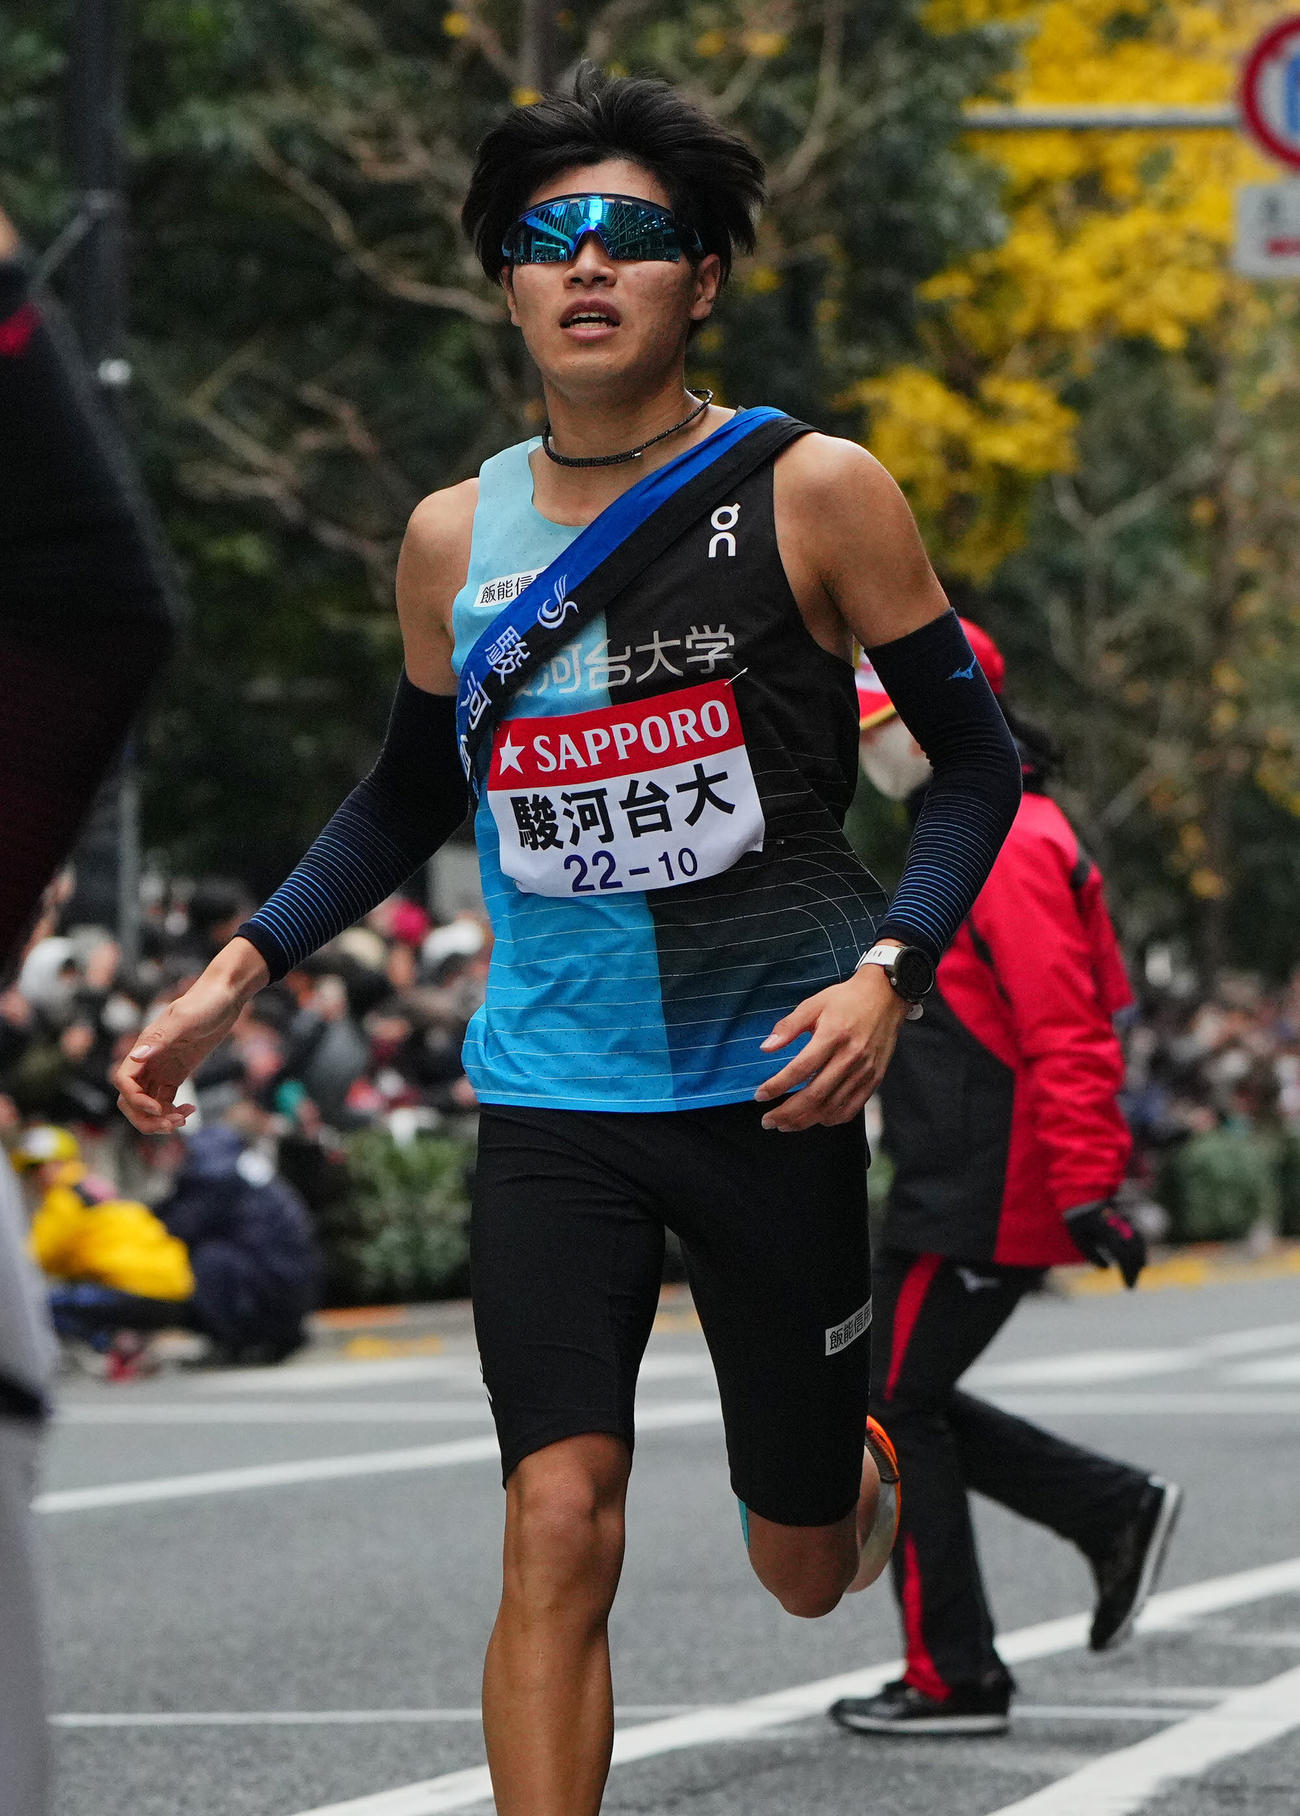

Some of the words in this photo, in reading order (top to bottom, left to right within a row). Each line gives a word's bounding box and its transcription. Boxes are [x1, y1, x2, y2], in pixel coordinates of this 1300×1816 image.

[479, 574, 541, 604] 飯能信
[515, 623, 736, 697] 河台大学
[532, 699, 730, 773] SAPPORO
[510, 763, 736, 851] 駿河台大
